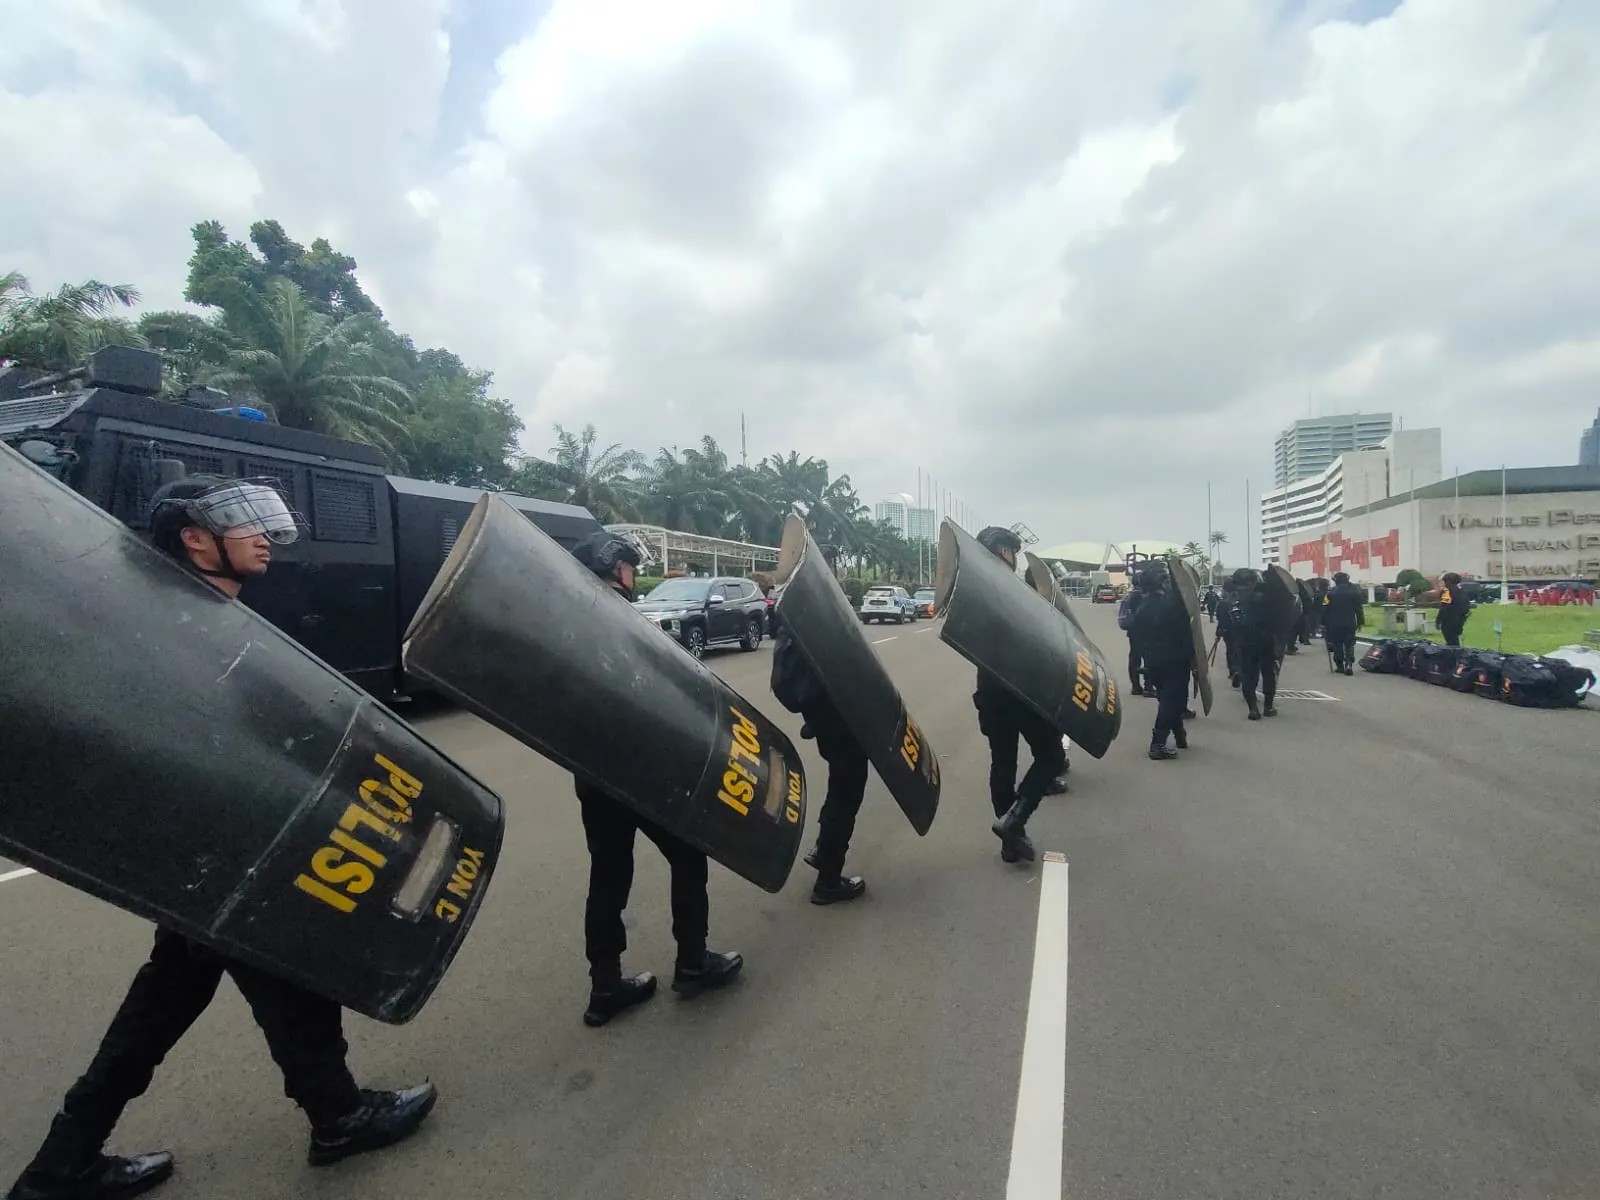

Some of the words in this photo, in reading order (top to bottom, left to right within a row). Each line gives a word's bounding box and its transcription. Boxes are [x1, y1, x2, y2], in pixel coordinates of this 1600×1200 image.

[717, 705, 761, 816] POLISI
[788, 770, 801, 807] YON
[293, 753, 423, 913] POLISI
[446, 847, 485, 900] YON
